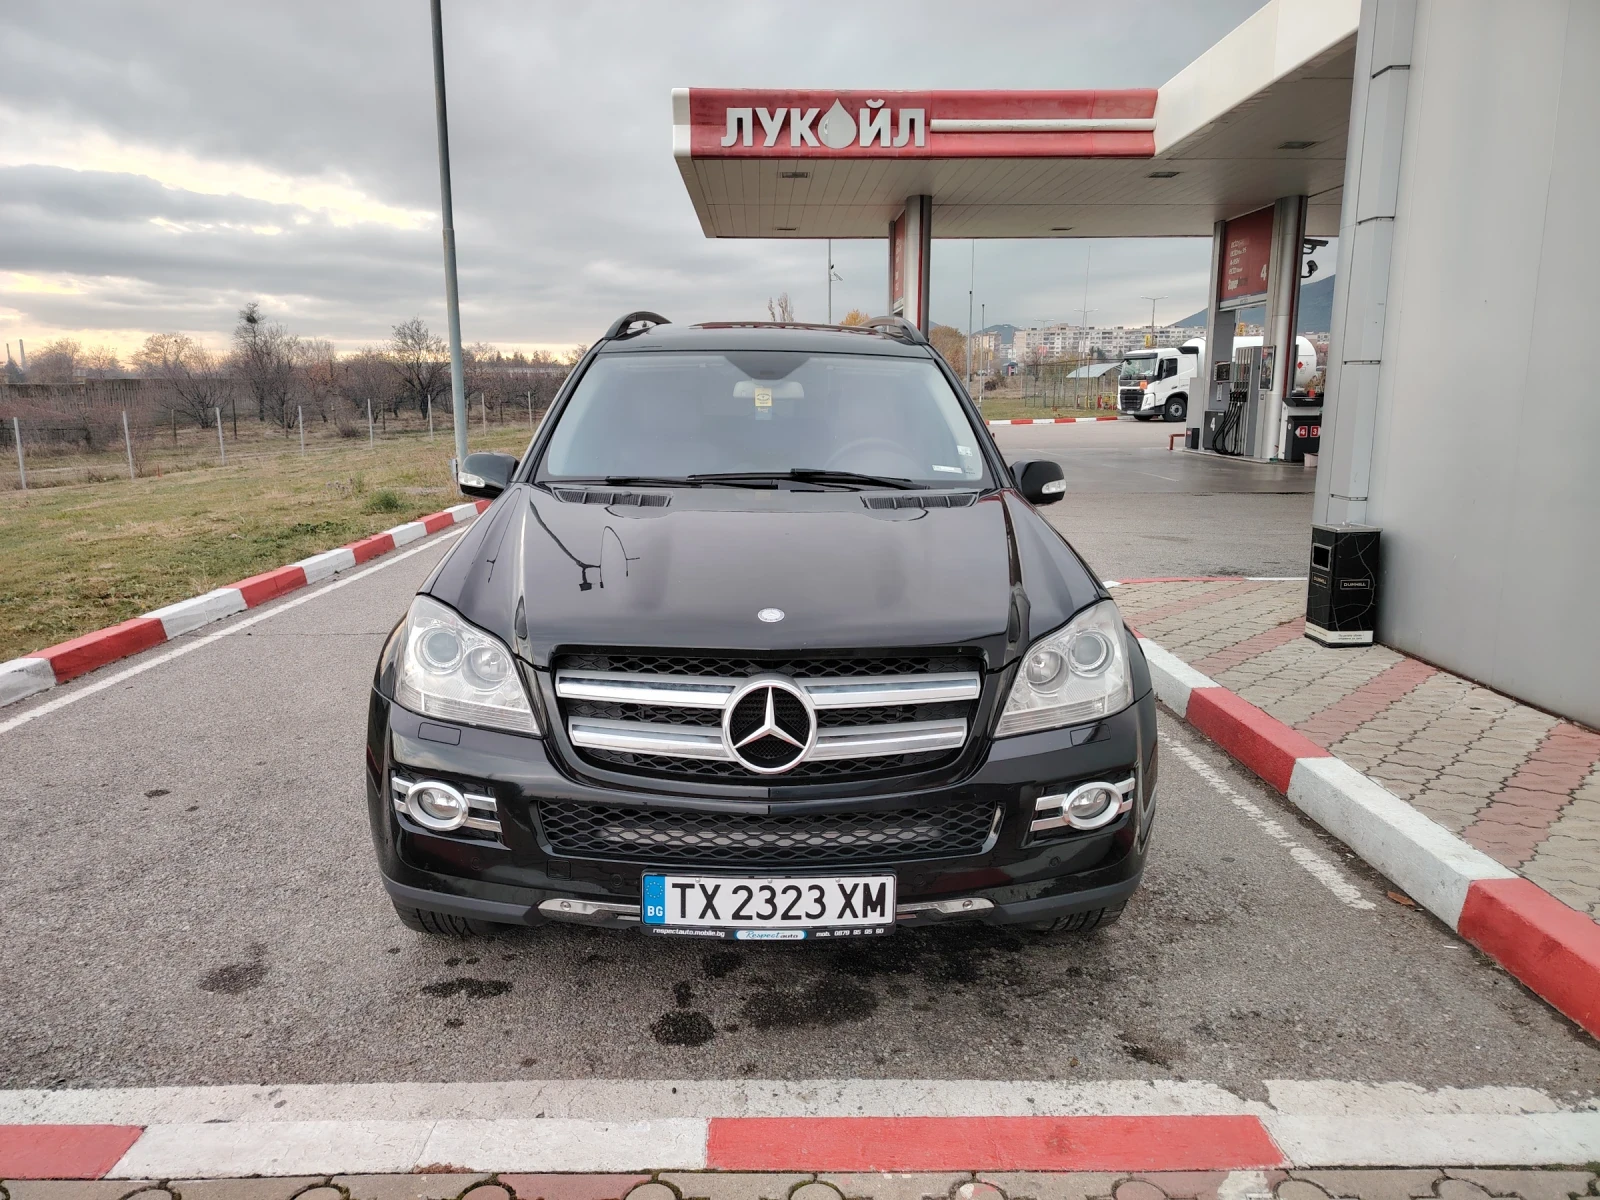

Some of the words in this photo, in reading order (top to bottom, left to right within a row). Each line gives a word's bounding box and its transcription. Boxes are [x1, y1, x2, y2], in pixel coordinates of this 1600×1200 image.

[721, 98, 926, 149] ЛУКОЙЛ
[1260, 264, 1267, 281] 4
[1210, 417, 1216, 431] 4
[671, 883, 721, 920] TX
[731, 885, 827, 920] 2323
[836, 882, 887, 919] XM
[647, 905, 664, 917] BG
[652, 928, 726, 938] respectauto.mobile.bg
